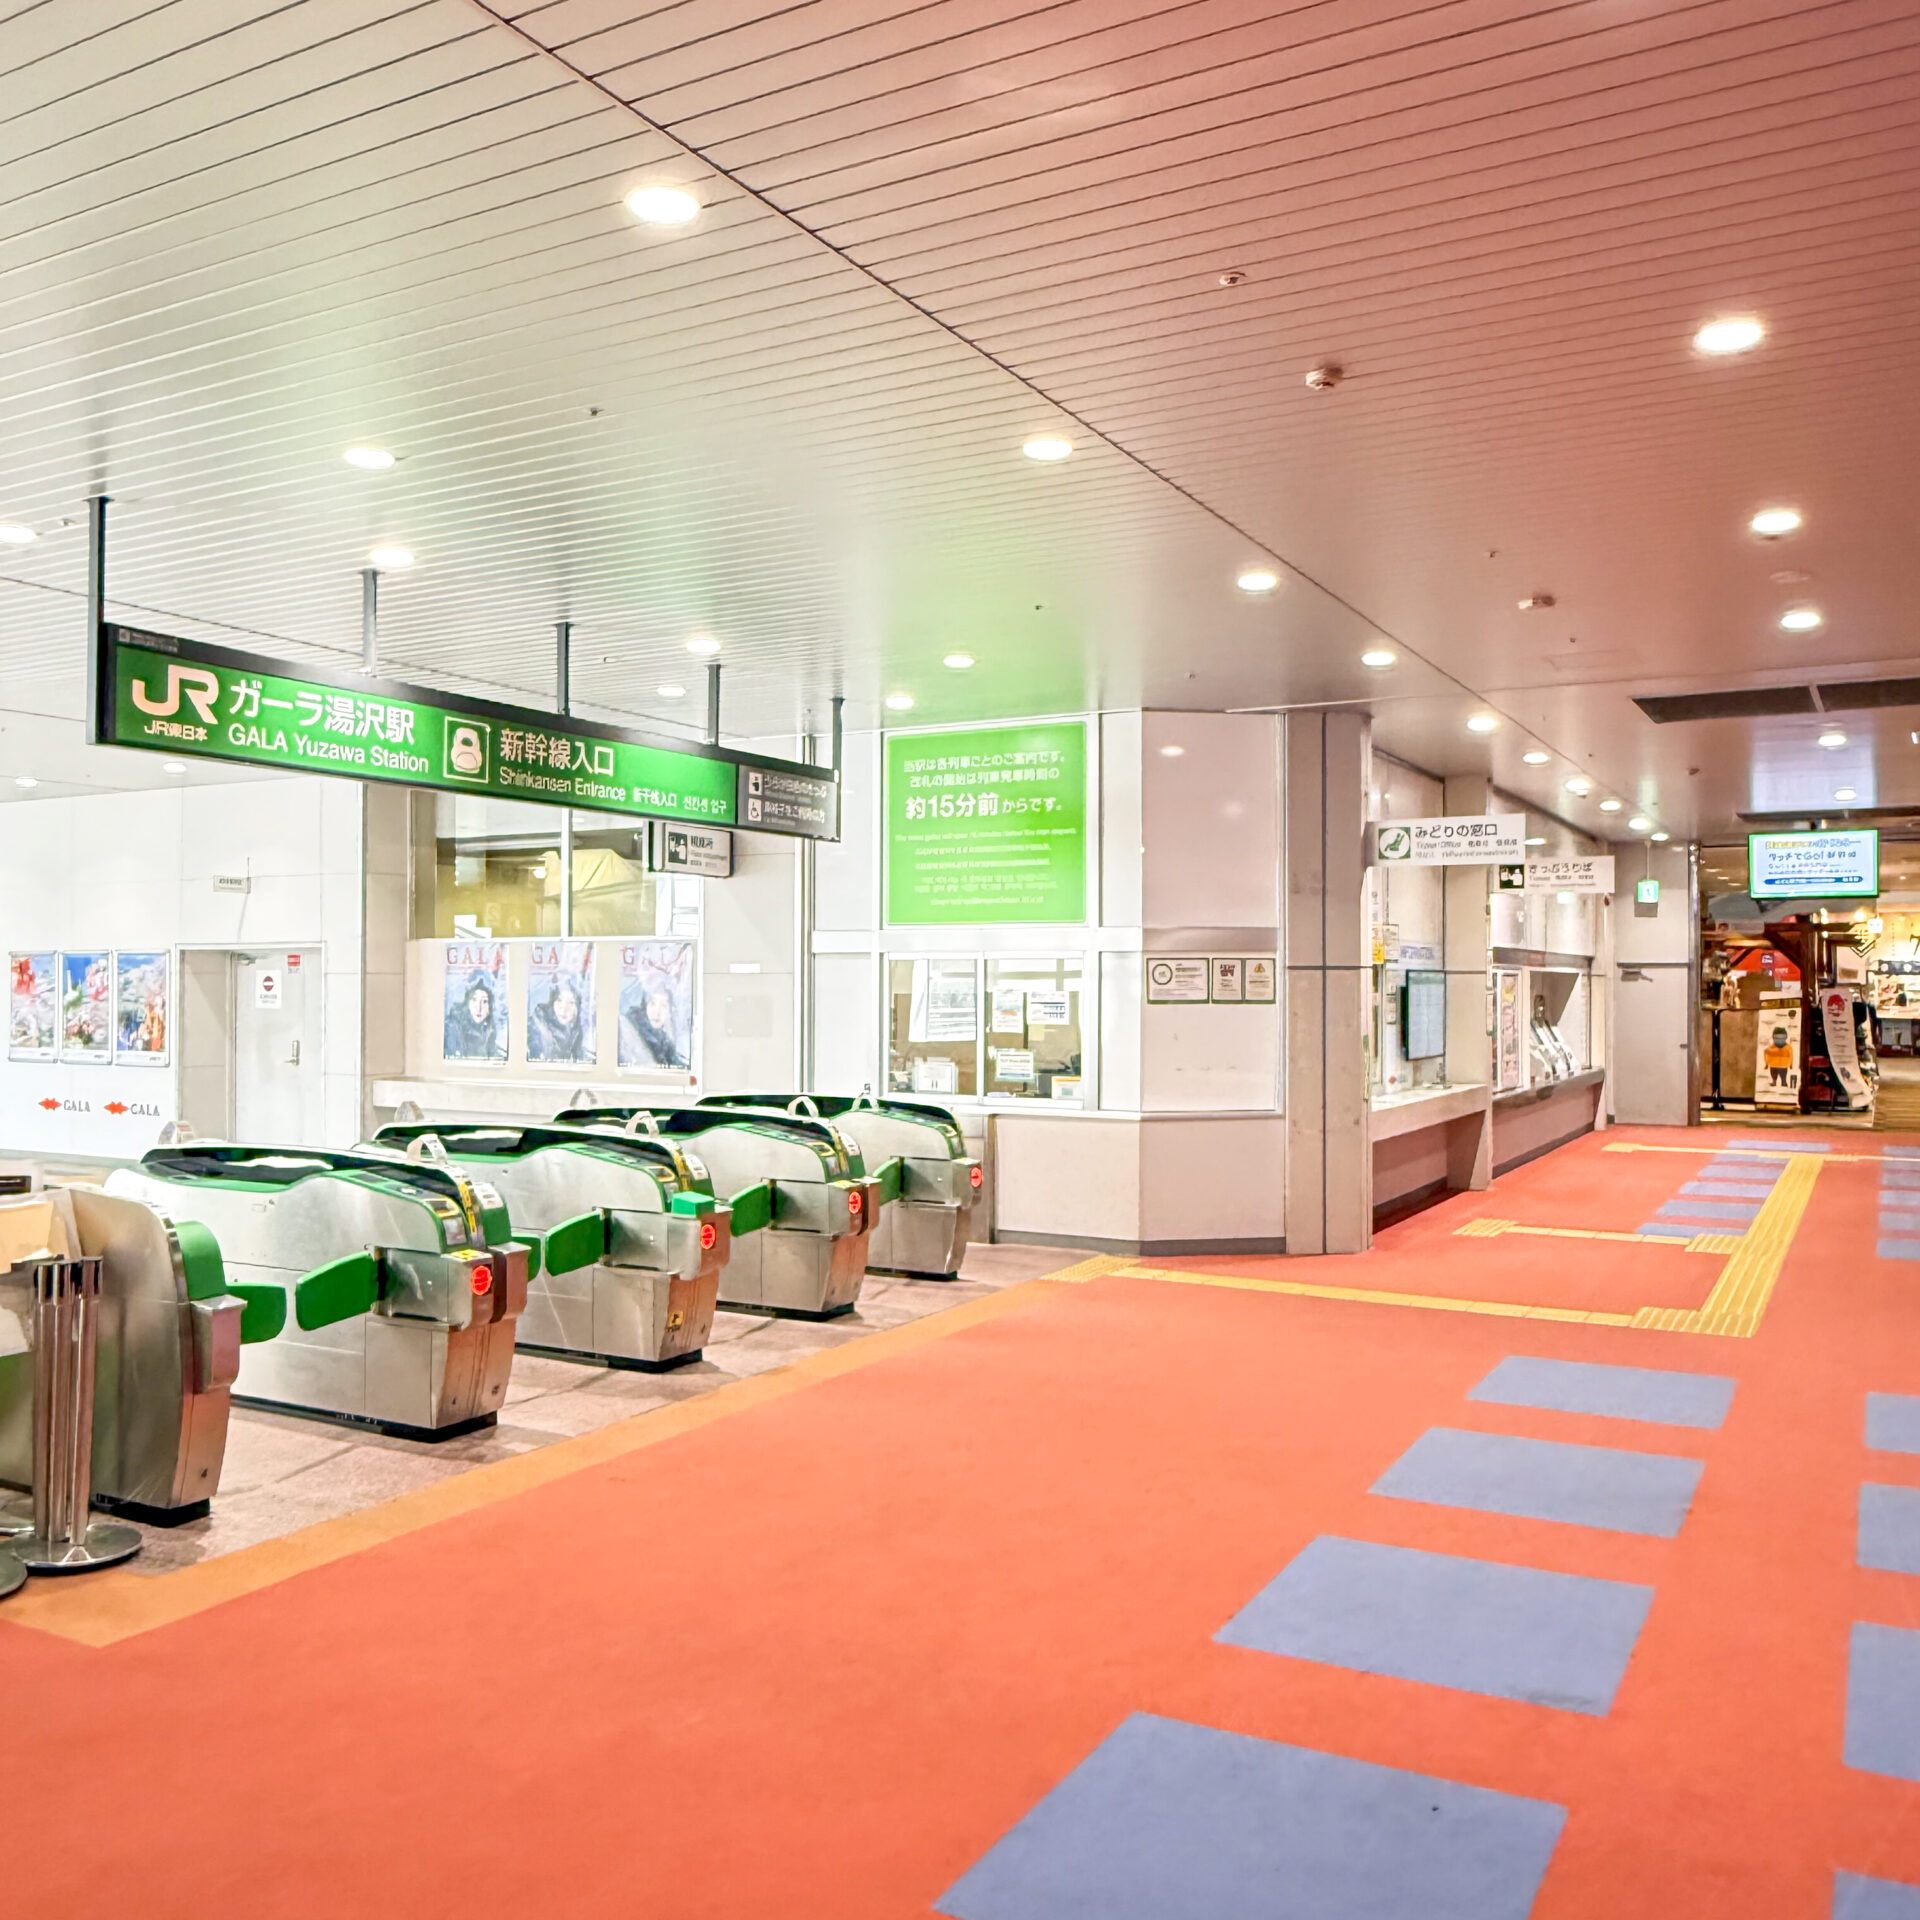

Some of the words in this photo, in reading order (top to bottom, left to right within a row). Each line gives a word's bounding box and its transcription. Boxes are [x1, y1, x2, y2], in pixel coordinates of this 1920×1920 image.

[131, 664, 219, 725] JR
[228, 679, 416, 745] ガーラ湯沢駅
[143, 719, 208, 742] JR東日本
[228, 723, 289, 753] GALA
[294, 732, 366, 764] Yuzawa
[369, 747, 430, 774] Station
[500, 727, 614, 776] 新幹線入口
[500, 766, 571, 793] Shinkansen
[574, 777, 627, 802] Entrance
[1415, 823, 1498, 839] みどりの窓口
